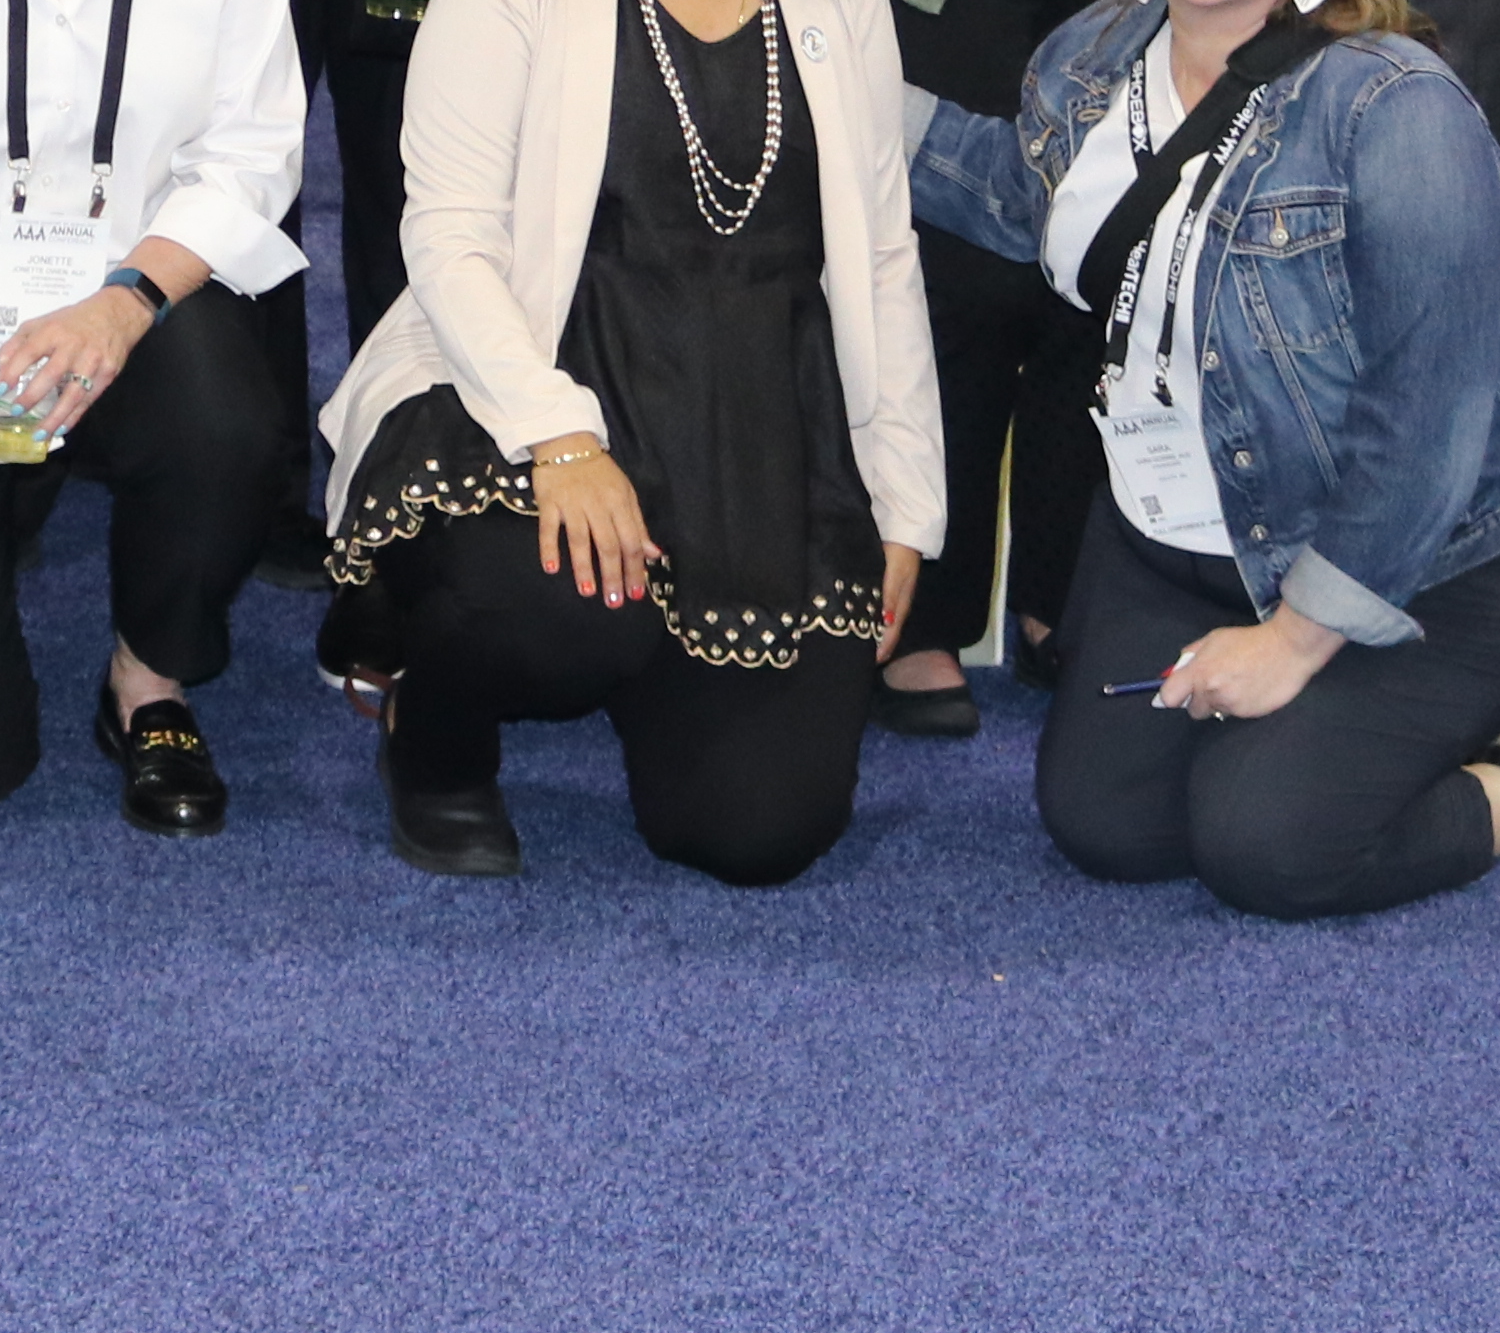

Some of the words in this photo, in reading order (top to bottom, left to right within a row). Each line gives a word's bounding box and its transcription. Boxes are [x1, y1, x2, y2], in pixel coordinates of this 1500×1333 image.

[1130, 59, 1149, 153] SHOEBOX
[13, 224, 46, 241] AAA
[50, 226, 95, 239] ANNUAL
[1167, 208, 1197, 304] SHOEBOX
[27, 255, 73, 267] JONETTE
